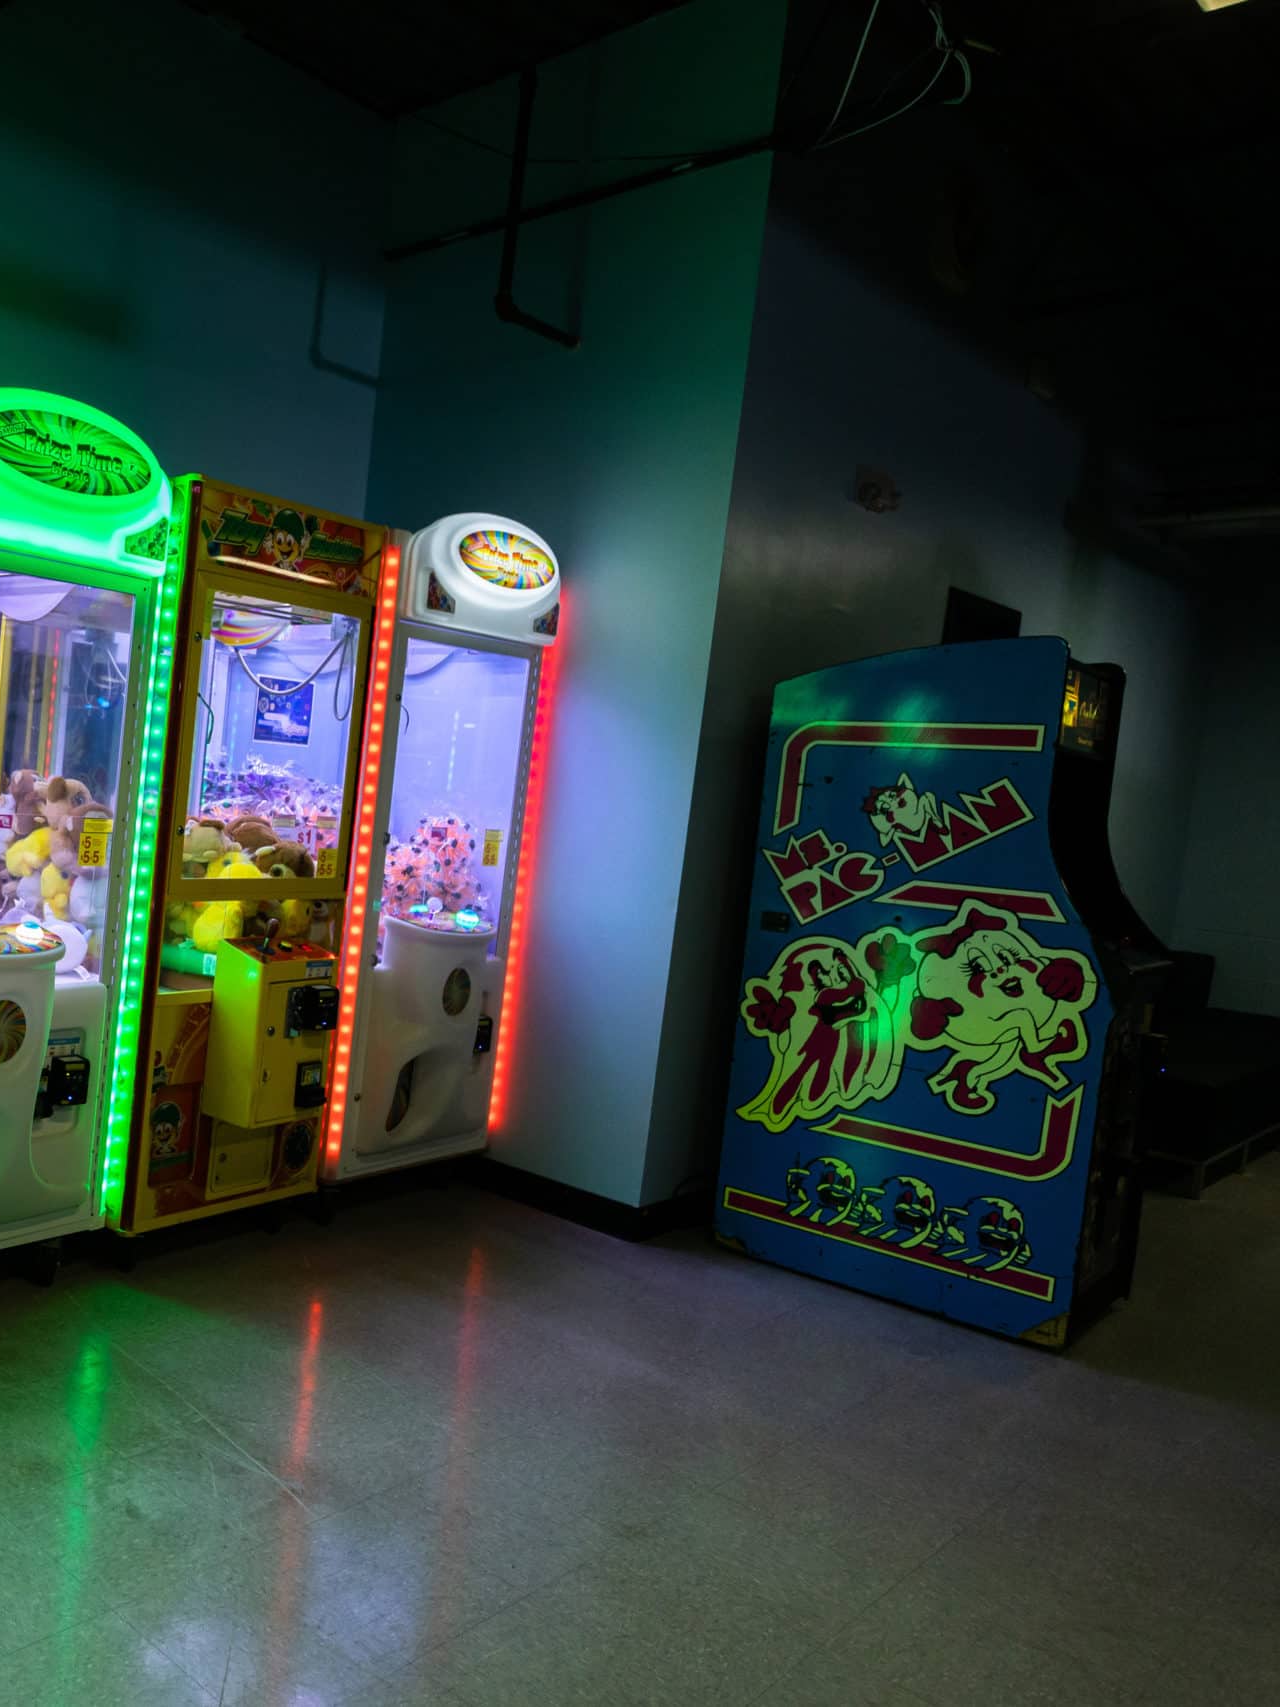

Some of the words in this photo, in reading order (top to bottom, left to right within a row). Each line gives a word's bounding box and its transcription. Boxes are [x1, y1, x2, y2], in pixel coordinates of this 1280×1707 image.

[24, 428, 71, 461] Prize
[77, 444, 123, 473] Time
[297, 829, 311, 844] $1
[763, 829, 847, 881] MS.
[780, 777, 1034, 925] PAC-MAN
